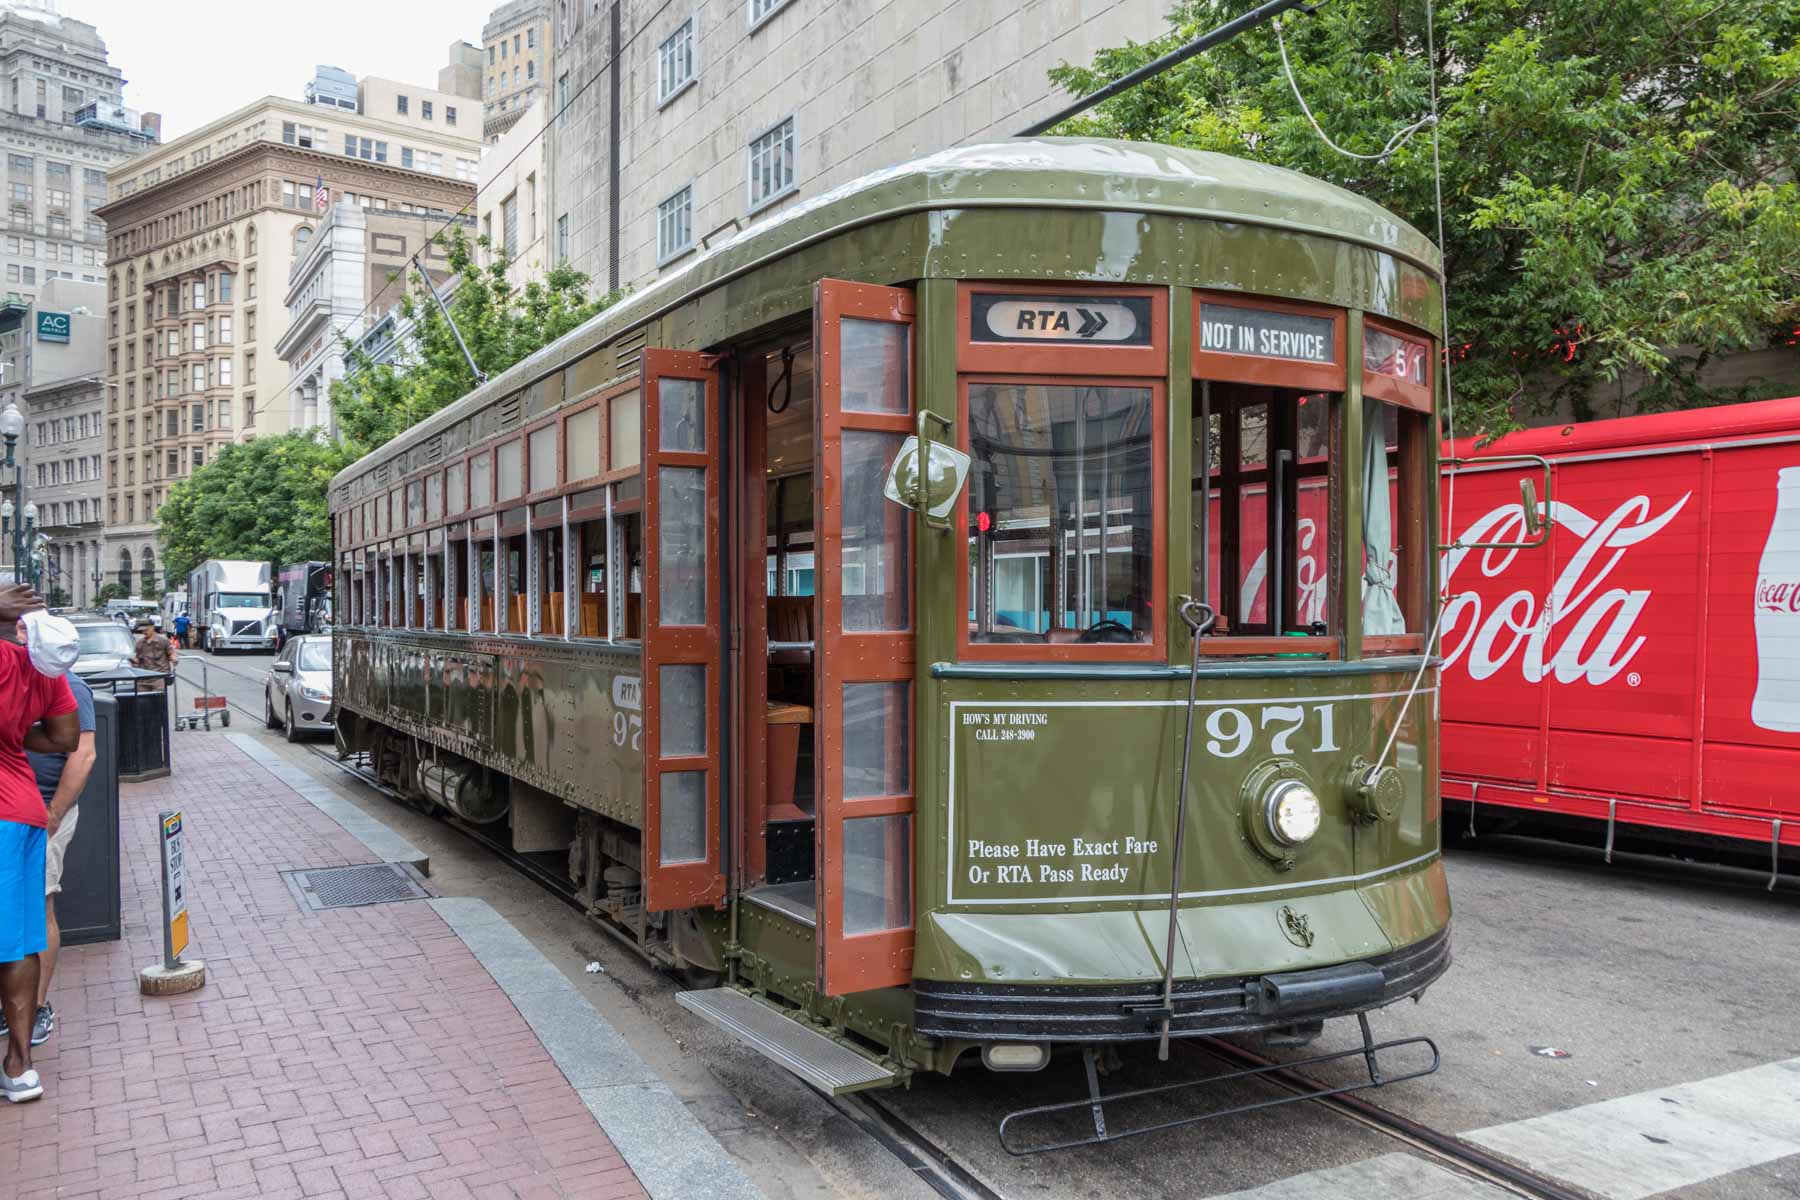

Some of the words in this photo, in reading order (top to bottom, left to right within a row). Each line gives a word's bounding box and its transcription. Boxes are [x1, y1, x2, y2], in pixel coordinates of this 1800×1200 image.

[42, 315, 67, 328] AC
[1016, 309, 1070, 331] RTA
[1201, 321, 1234, 350] NOT
[1238, 326, 1255, 352] IN
[1260, 328, 1325, 360] SERVICE
[621, 682, 638, 704] RTA
[962, 713, 991, 725] HOW'S
[992, 713, 1008, 725] MY
[1009, 713, 1048, 725] DRIVING
[975, 729, 999, 741] CALL
[1001, 729, 1036, 741] 248-3900
[1206, 703, 1341, 758] 971
[968, 839, 1020, 858] Please
[1026, 839, 1066, 857] Have
[1072, 838, 1119, 856] Exact
[1125, 836, 1158, 854] Fare
[968, 865, 990, 884] Or
[997, 864, 1033, 884] RTA
[1039, 864, 1074, 883] Pass
[1081, 863, 1129, 883] Ready
